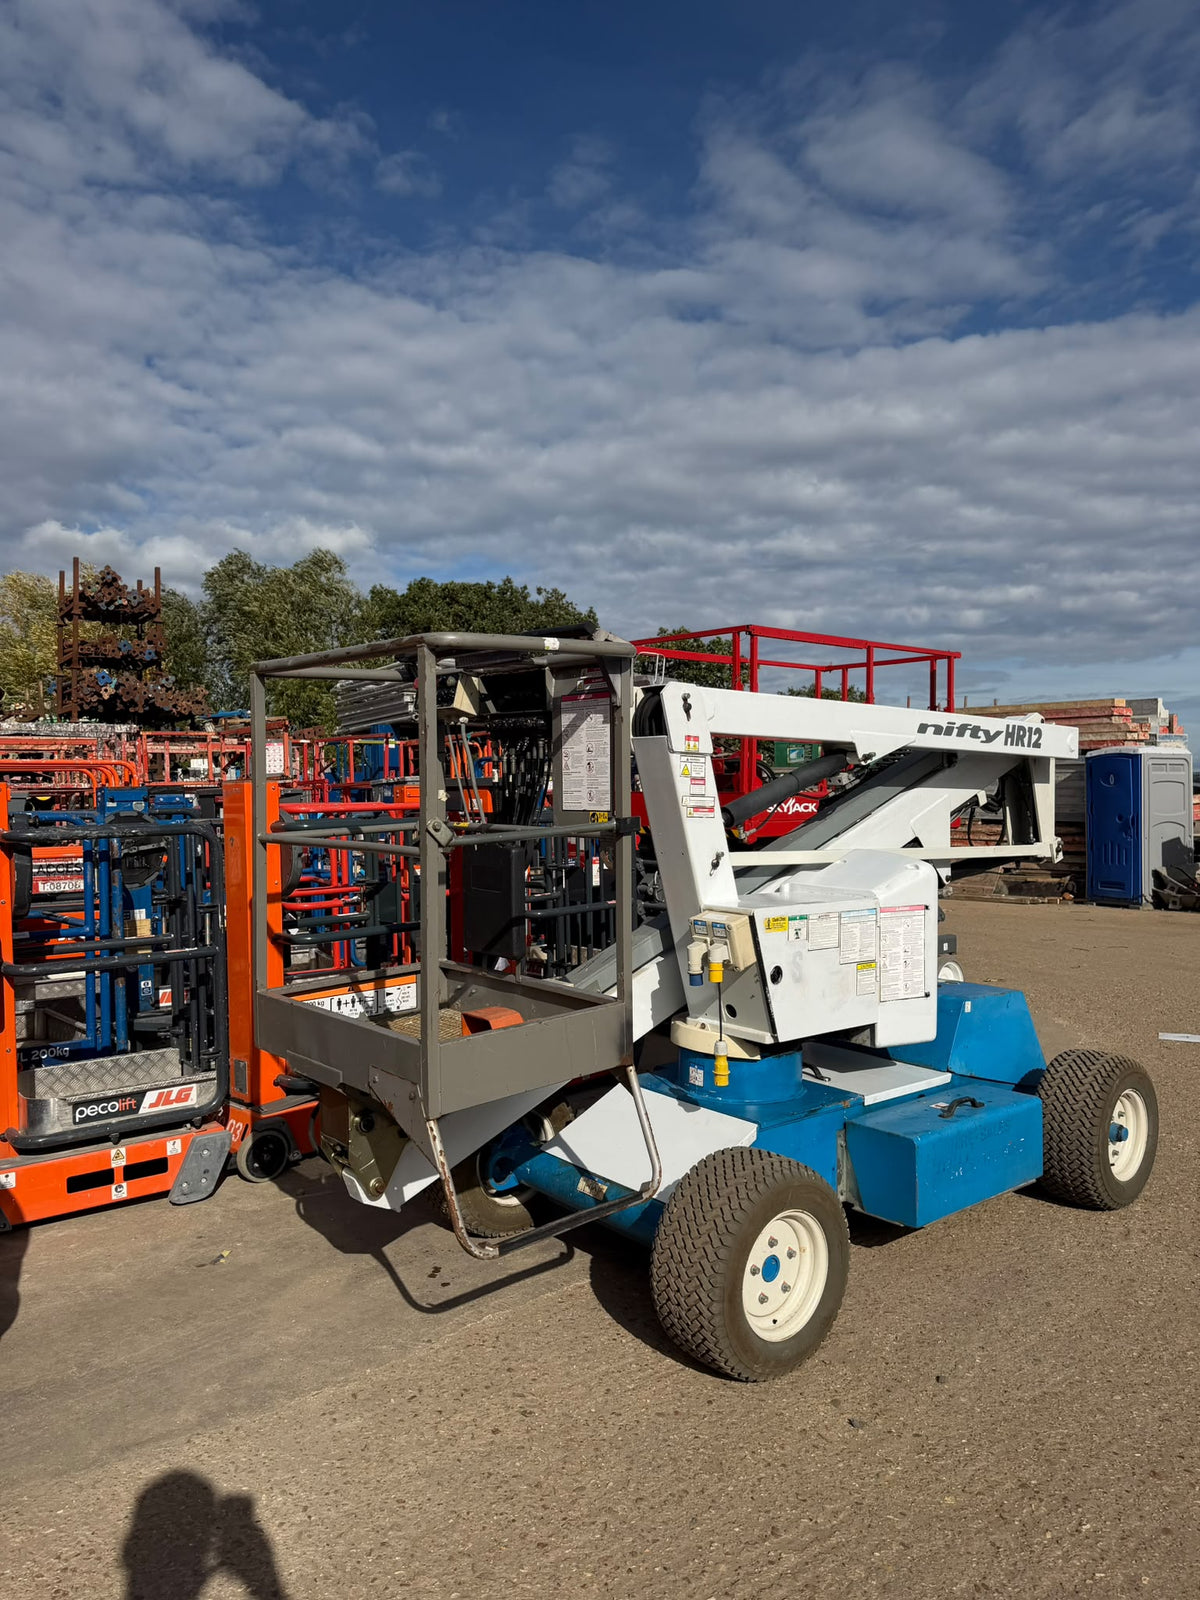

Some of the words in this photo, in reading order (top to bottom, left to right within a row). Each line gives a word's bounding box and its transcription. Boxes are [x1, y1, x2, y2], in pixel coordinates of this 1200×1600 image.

[917, 721, 1004, 744] nifty
[1003, 723, 1043, 749] HR12
[75, 1096, 137, 1123] pecolift
[148, 1087, 194, 1109] JLG
